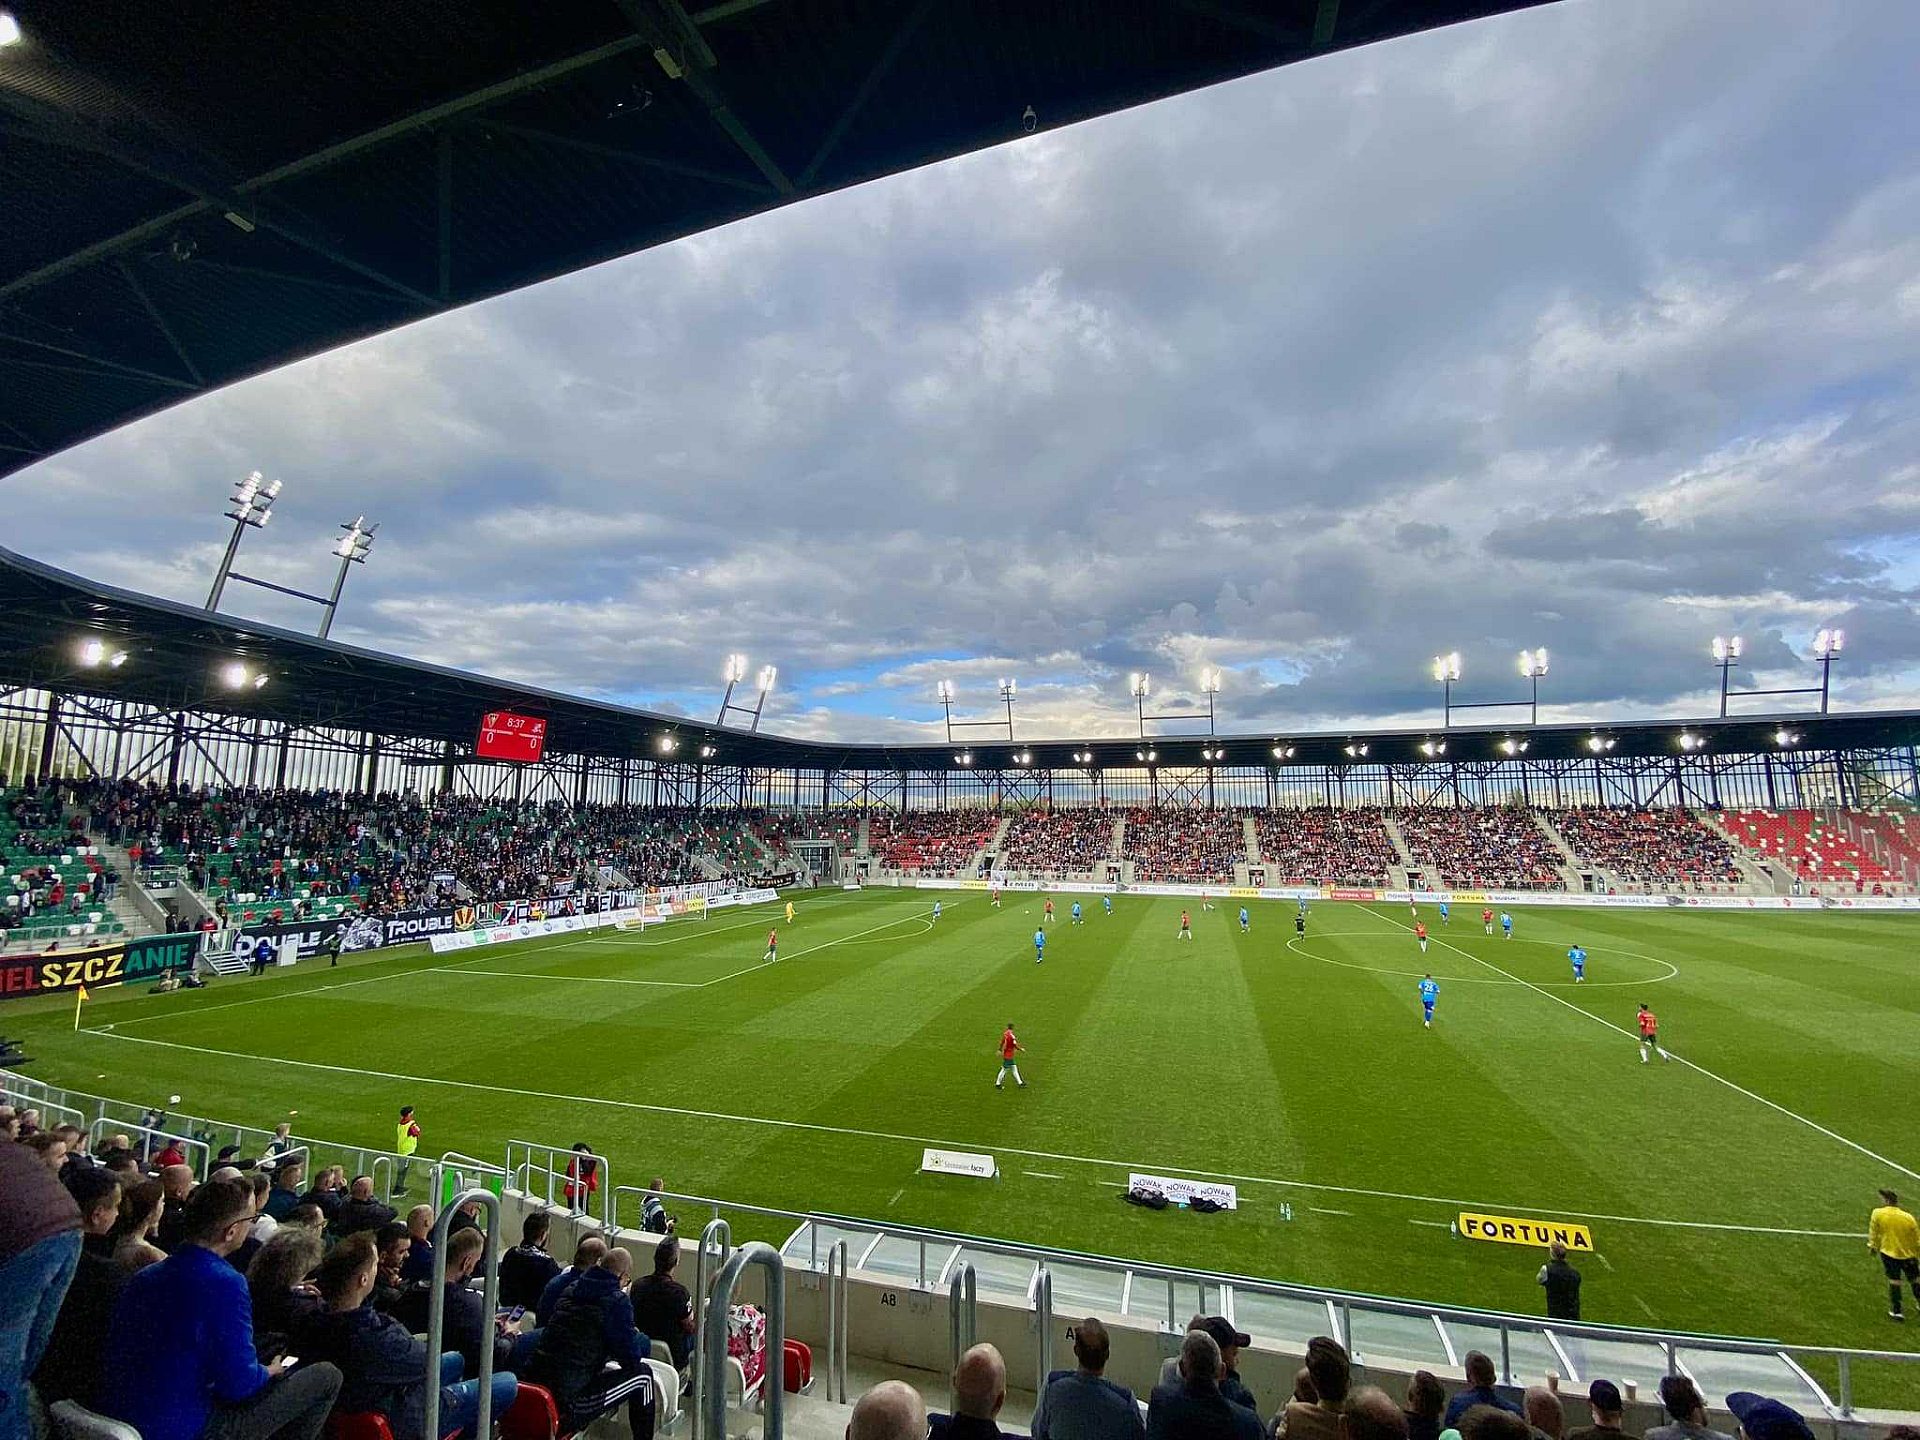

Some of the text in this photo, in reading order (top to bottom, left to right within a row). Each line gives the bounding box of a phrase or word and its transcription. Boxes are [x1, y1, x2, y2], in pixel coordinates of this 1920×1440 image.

[487, 732, 537, 749] 0 0
[387, 915, 452, 939] TROUBLE
[1166, 1184, 1196, 1193] NOWAK
[1200, 1187, 1231, 1198] NOWAK
[1466, 1219, 1588, 1248] FORTUNA
[881, 1292, 896, 1306] A8
